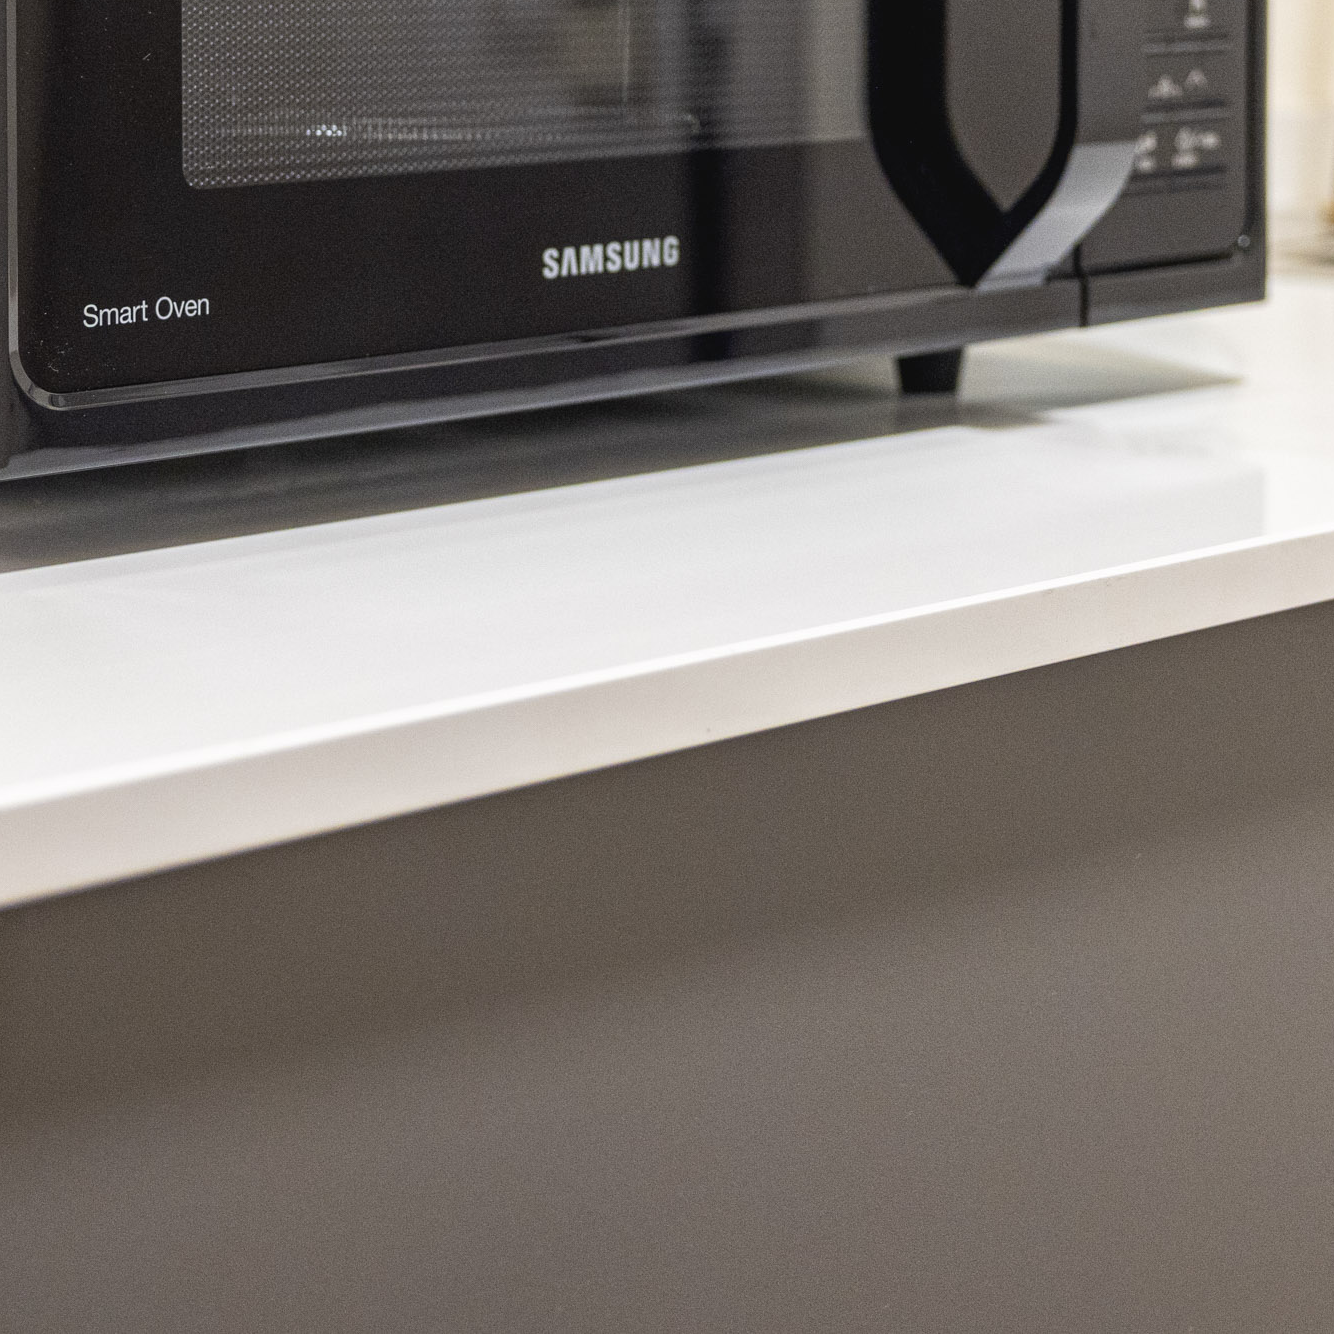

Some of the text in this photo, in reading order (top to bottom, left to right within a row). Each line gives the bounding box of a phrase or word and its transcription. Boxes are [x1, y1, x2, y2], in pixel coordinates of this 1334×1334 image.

[542, 235, 680, 280] SAMSUNG
[82, 296, 210, 328] Smart Oven
